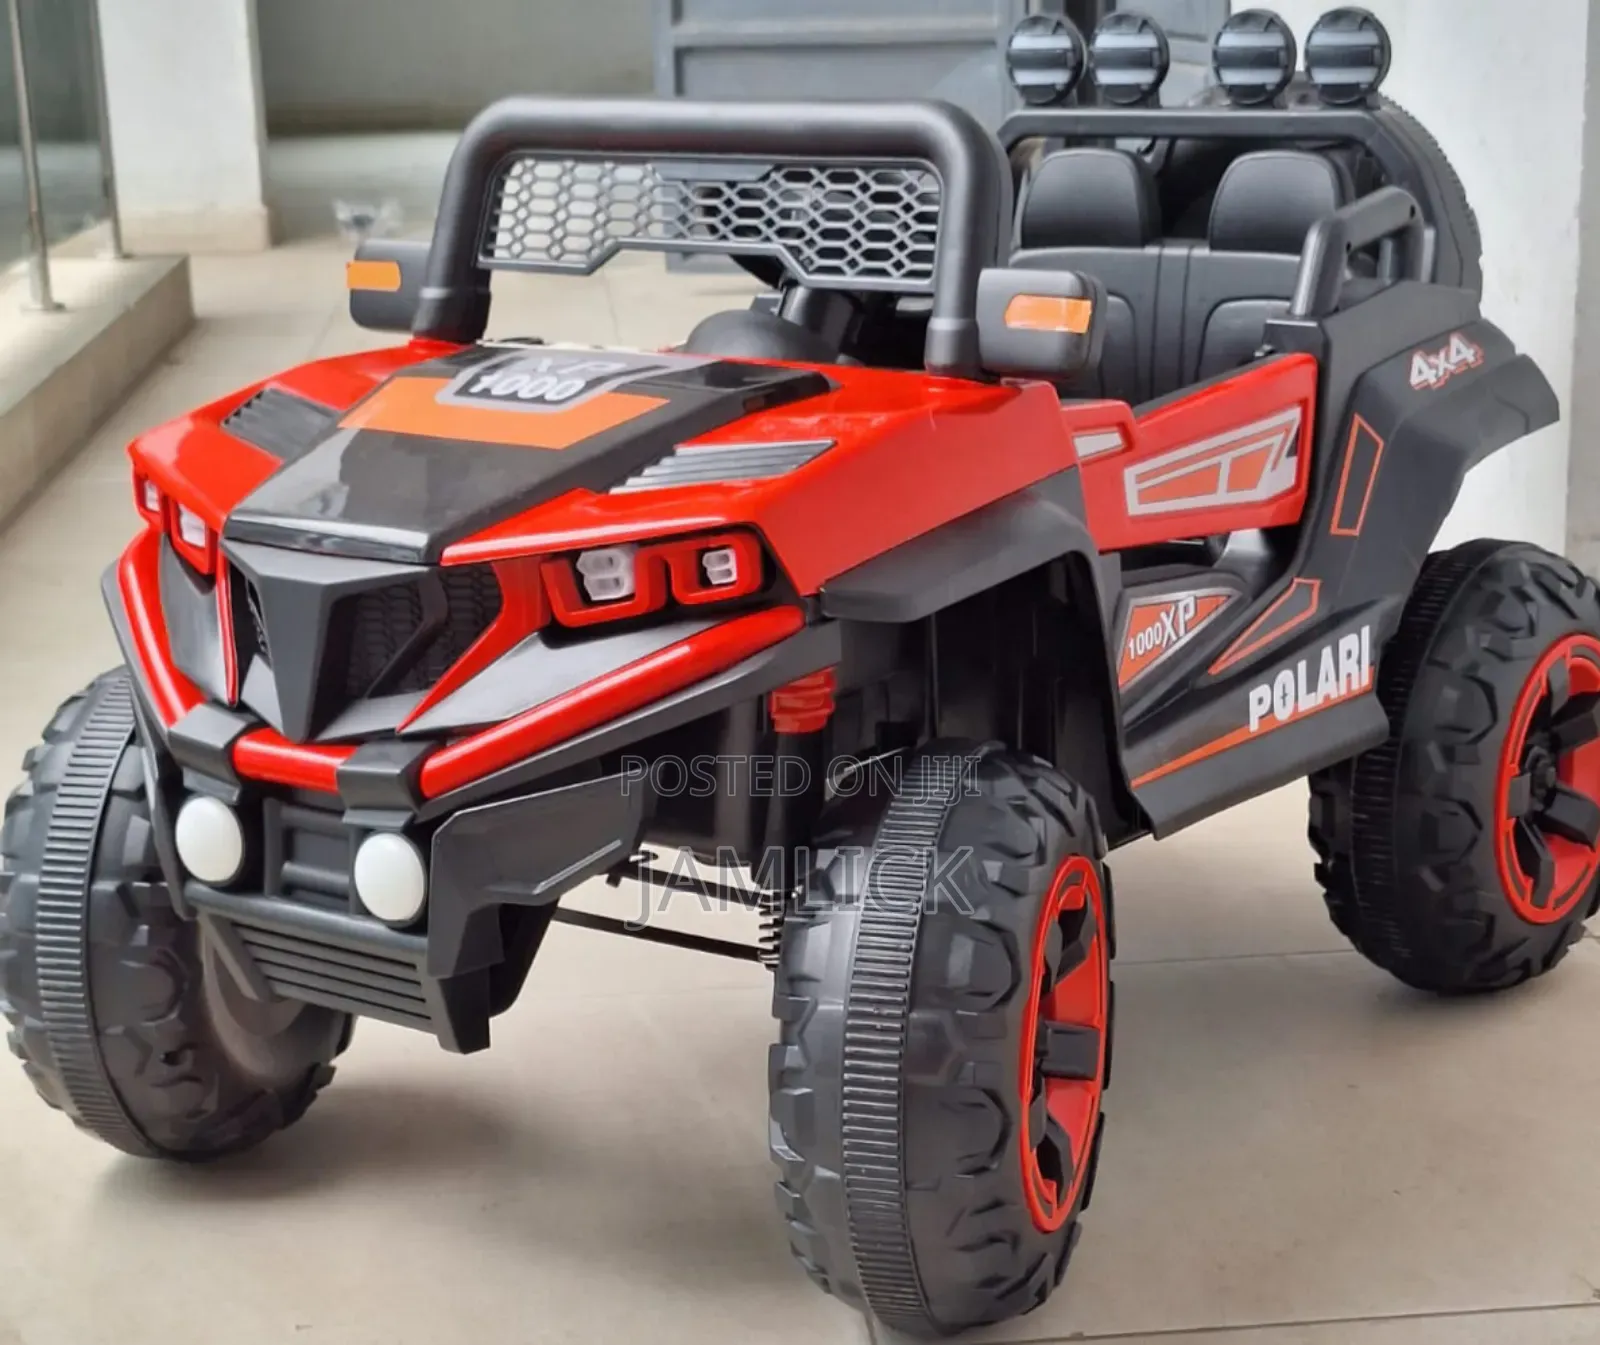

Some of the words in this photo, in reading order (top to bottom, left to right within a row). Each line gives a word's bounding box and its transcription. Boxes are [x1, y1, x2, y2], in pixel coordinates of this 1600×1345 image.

[470, 372, 586, 401] 1000
[1409, 332, 1484, 389] 4x4
[1249, 624, 1371, 732] POLARI
